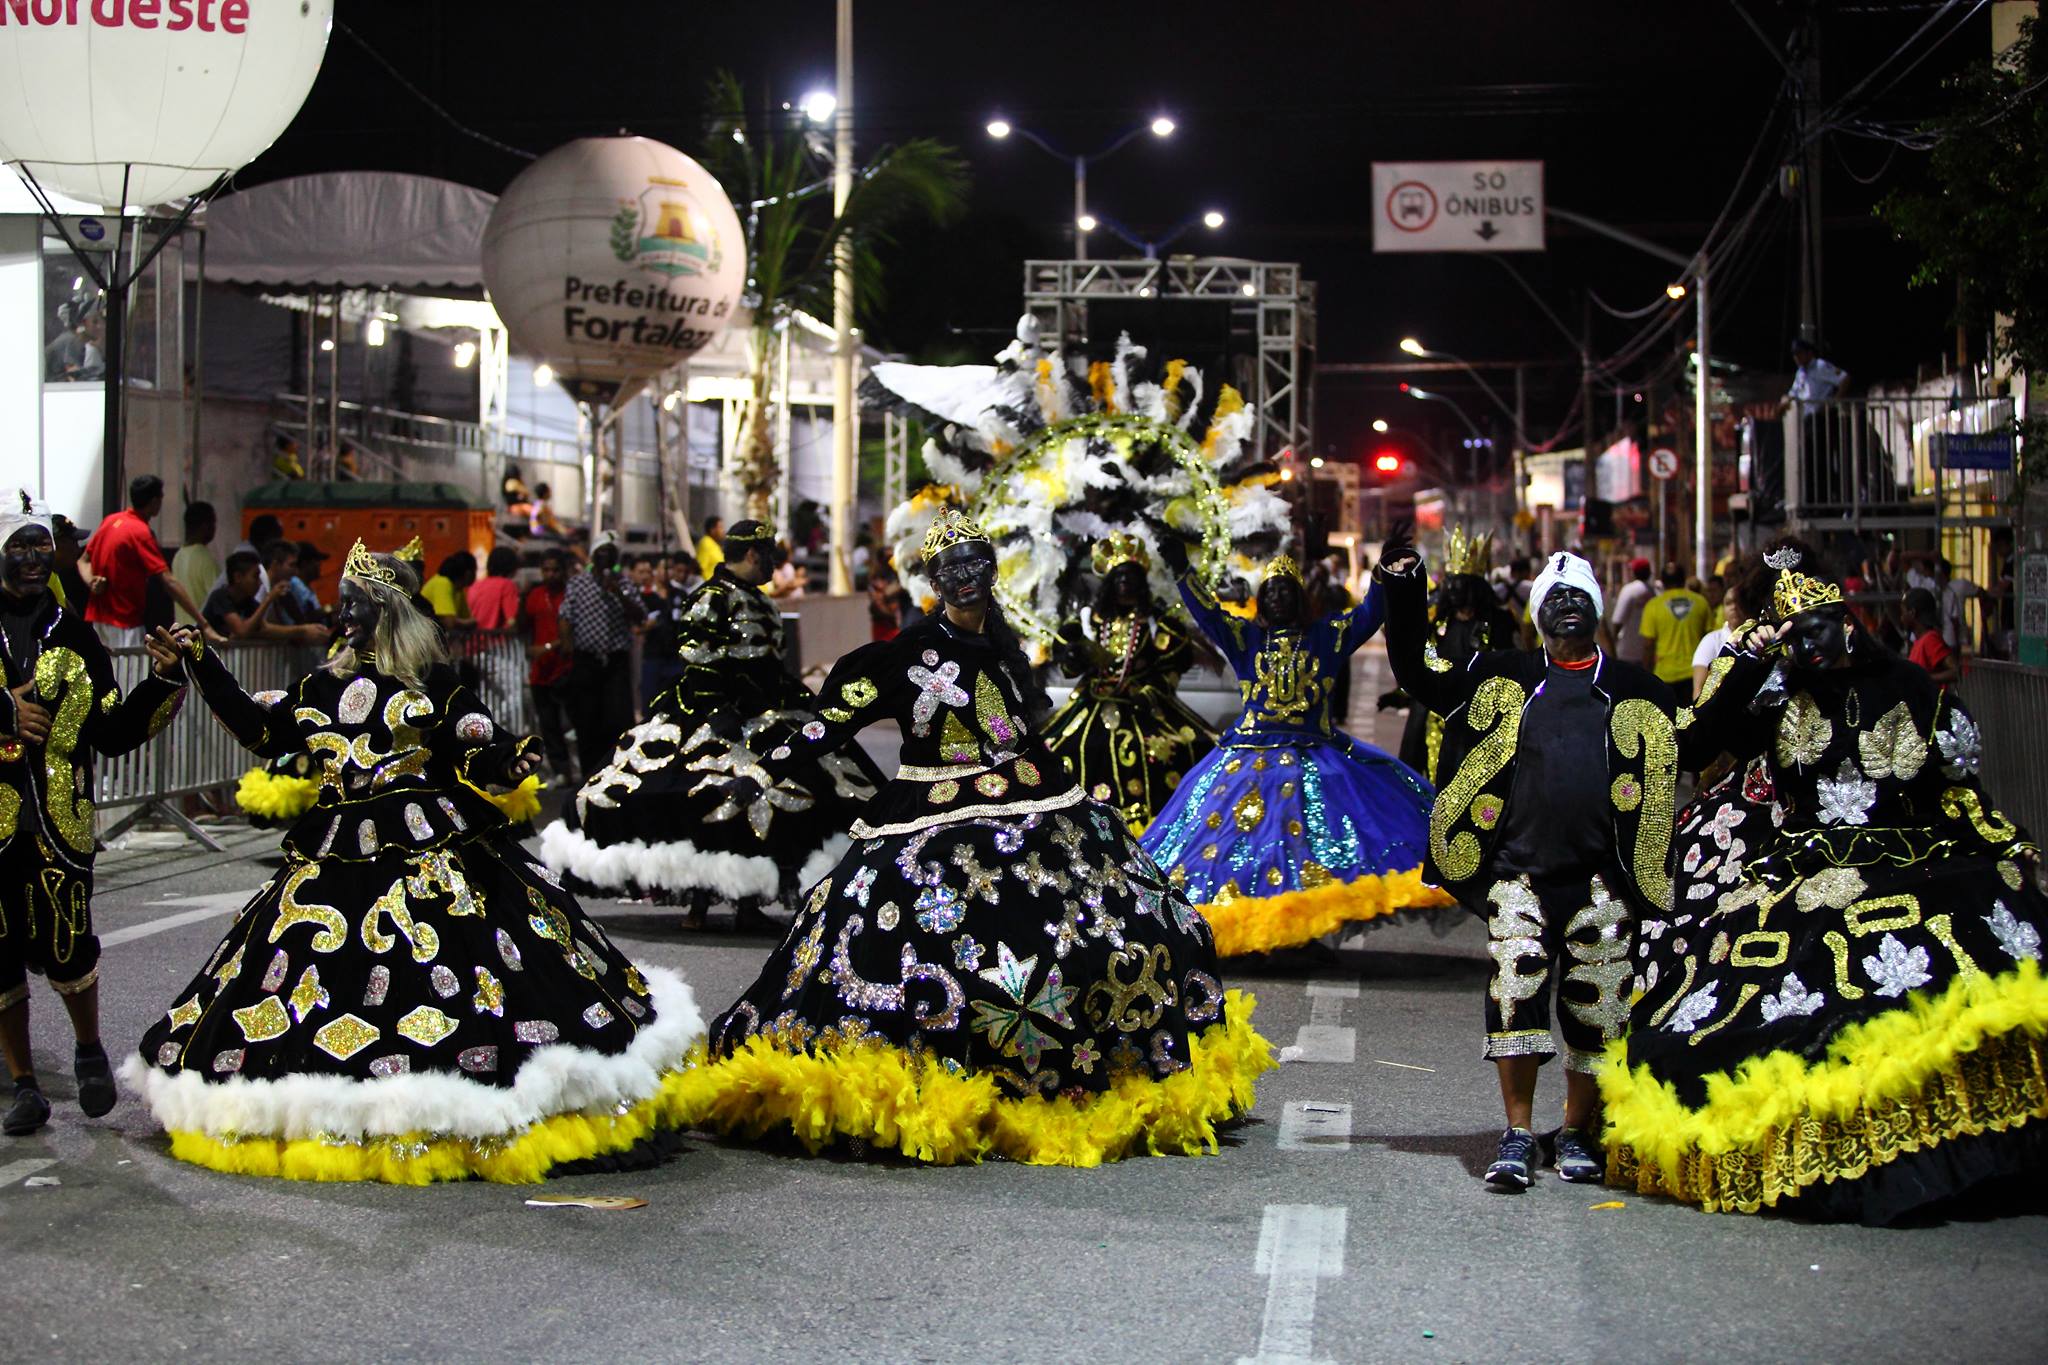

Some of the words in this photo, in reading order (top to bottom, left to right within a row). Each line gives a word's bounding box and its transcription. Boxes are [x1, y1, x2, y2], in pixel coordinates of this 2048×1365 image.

[1473, 169, 1507, 191] SÓ
[1446, 192, 1535, 216] ÔNIBUS
[565, 275, 710, 316] Prefeitura
